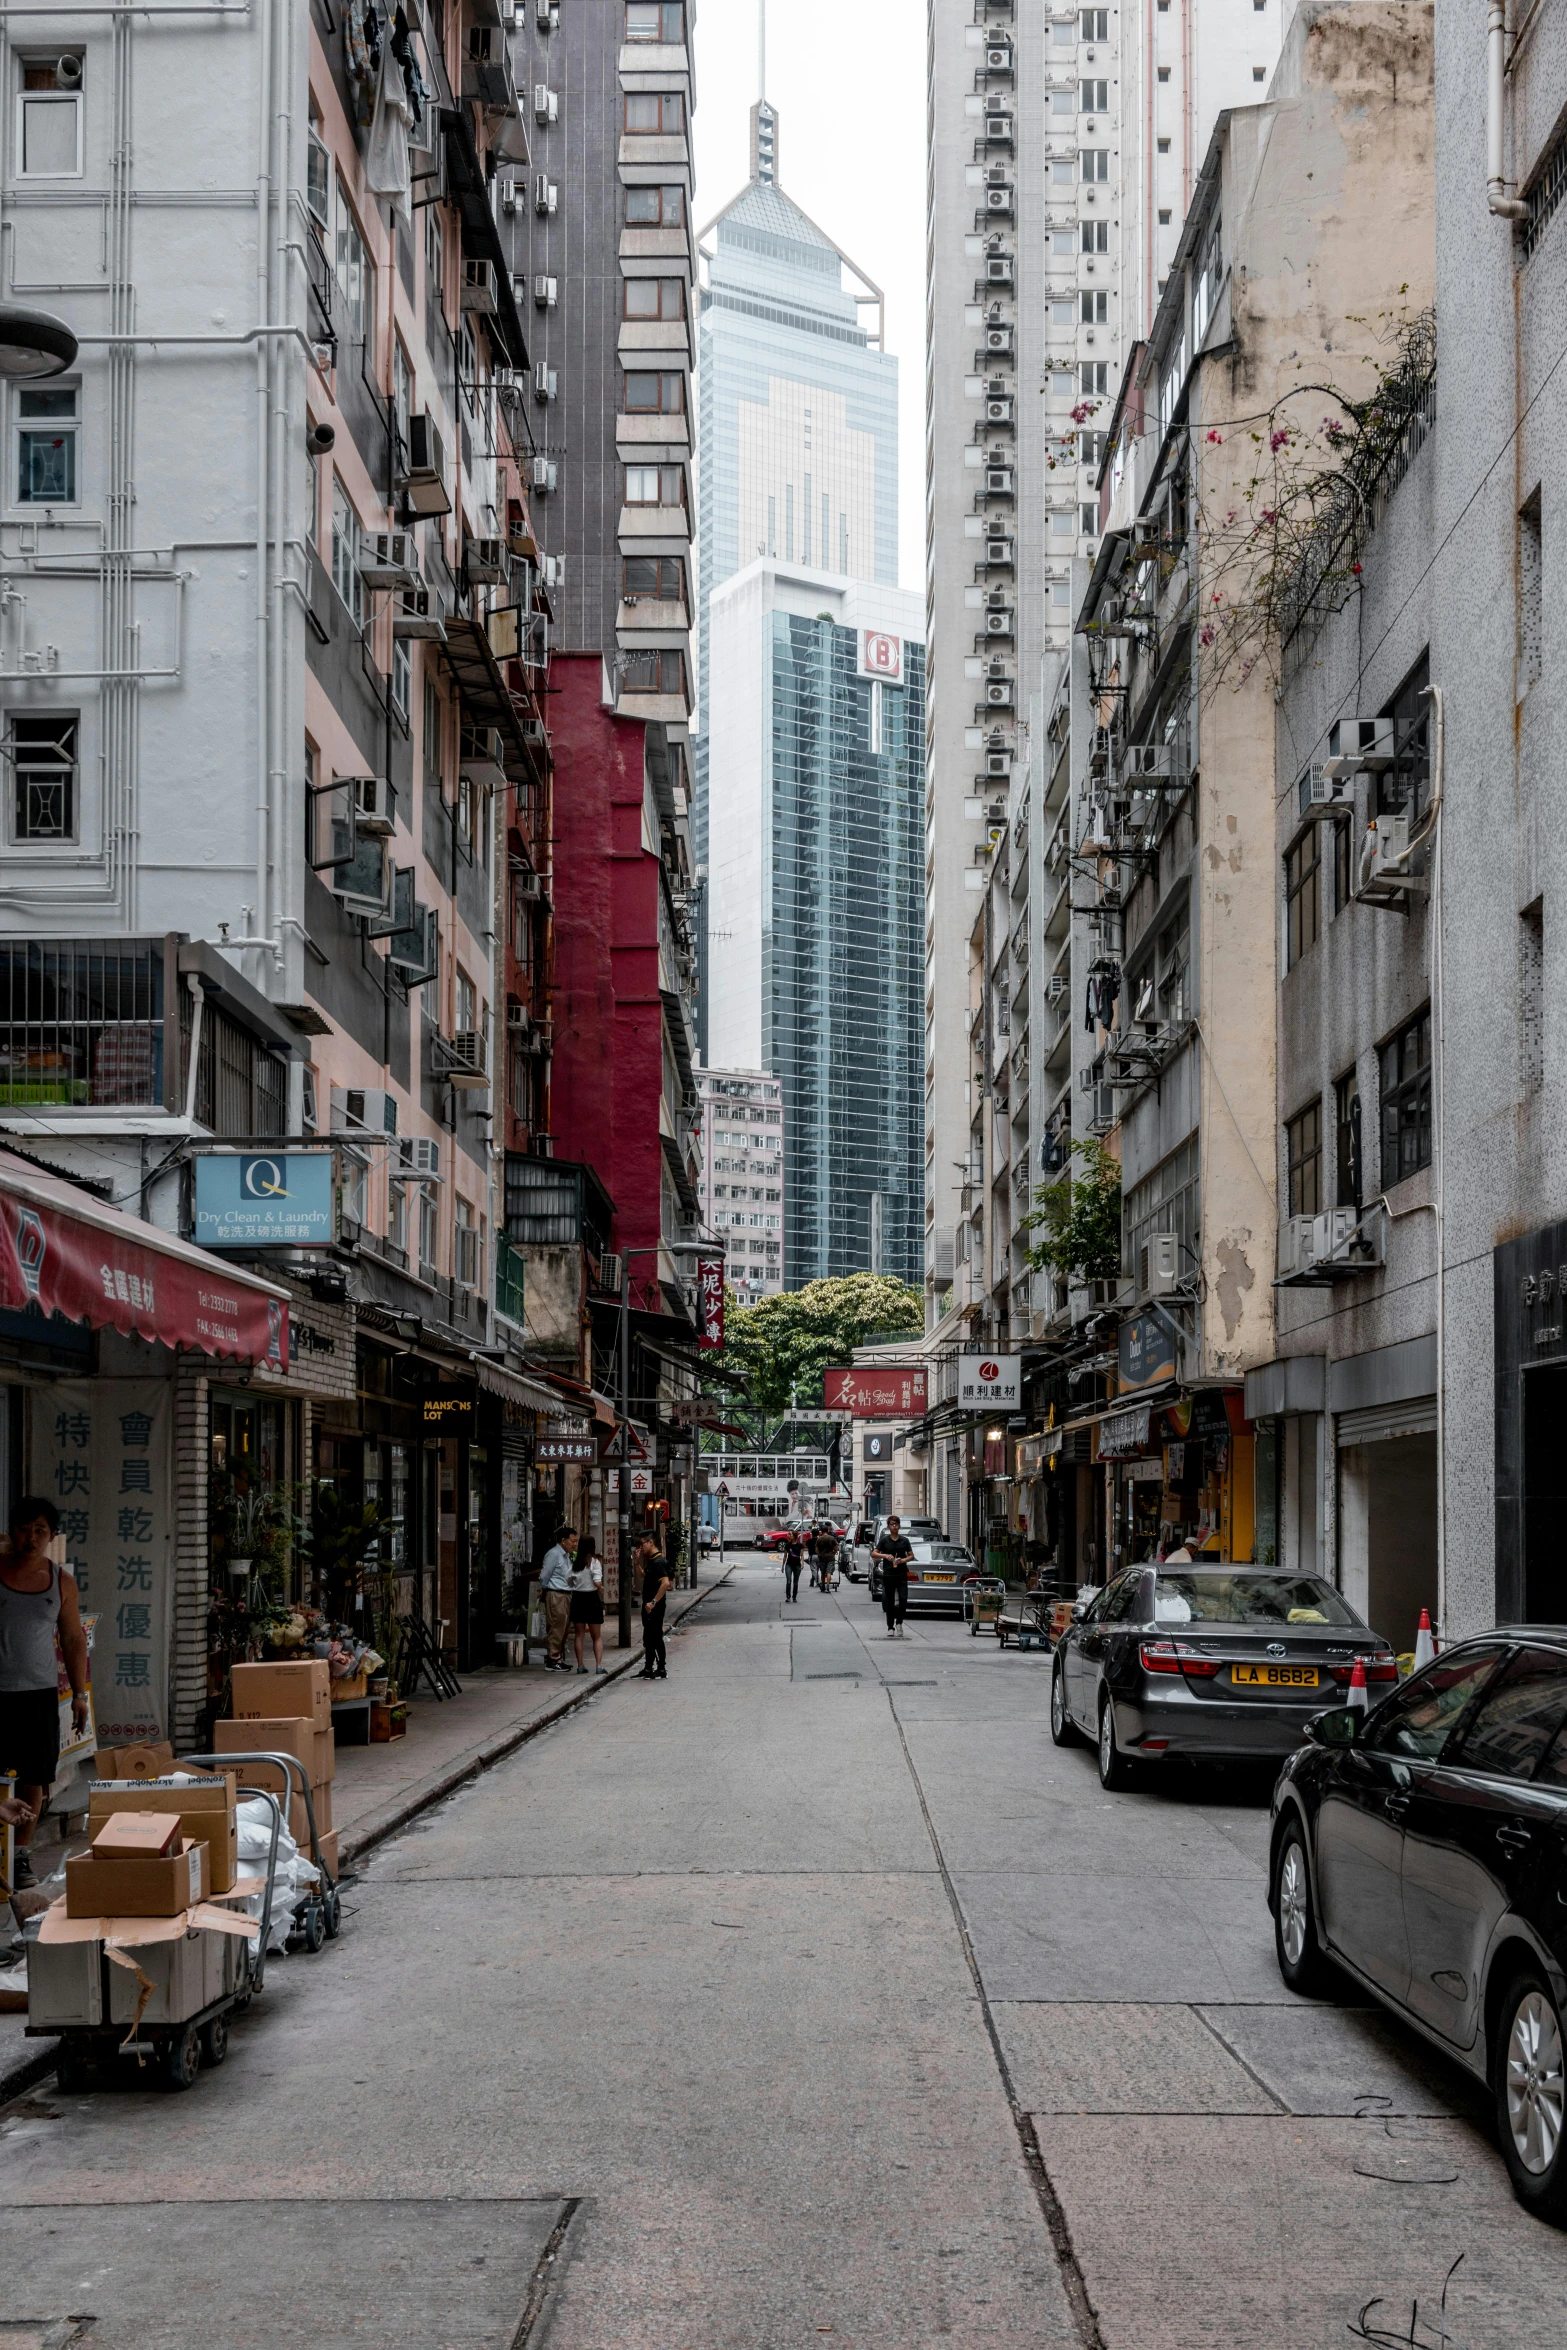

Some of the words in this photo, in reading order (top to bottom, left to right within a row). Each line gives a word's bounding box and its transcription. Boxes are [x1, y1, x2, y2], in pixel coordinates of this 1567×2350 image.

[877, 639, 889, 667] B
[246, 1159, 298, 1198] Q
[198, 1211, 221, 1226] Dry
[225, 1211, 260, 1223] Clean
[264, 1211, 275, 1222] &
[279, 1210, 329, 1225] Laundry
[217, 1225, 310, 1238] 乾洗及磅洗服務
[913, 1373, 925, 1396] 喜帖
[963, 1385, 1015, 1397] 順利建材
[901, 1381, 911, 1408] 利是封
[424, 1400, 472, 1411] MANSONS
[424, 1411, 442, 1420] LOT
[115, 1410, 156, 1688] 會員乾洗優惠
[1236, 1667, 1259, 1682] LA
[1268, 1668, 1315, 1684] 8682
[127, 1779, 174, 1788] AkzoNobel
